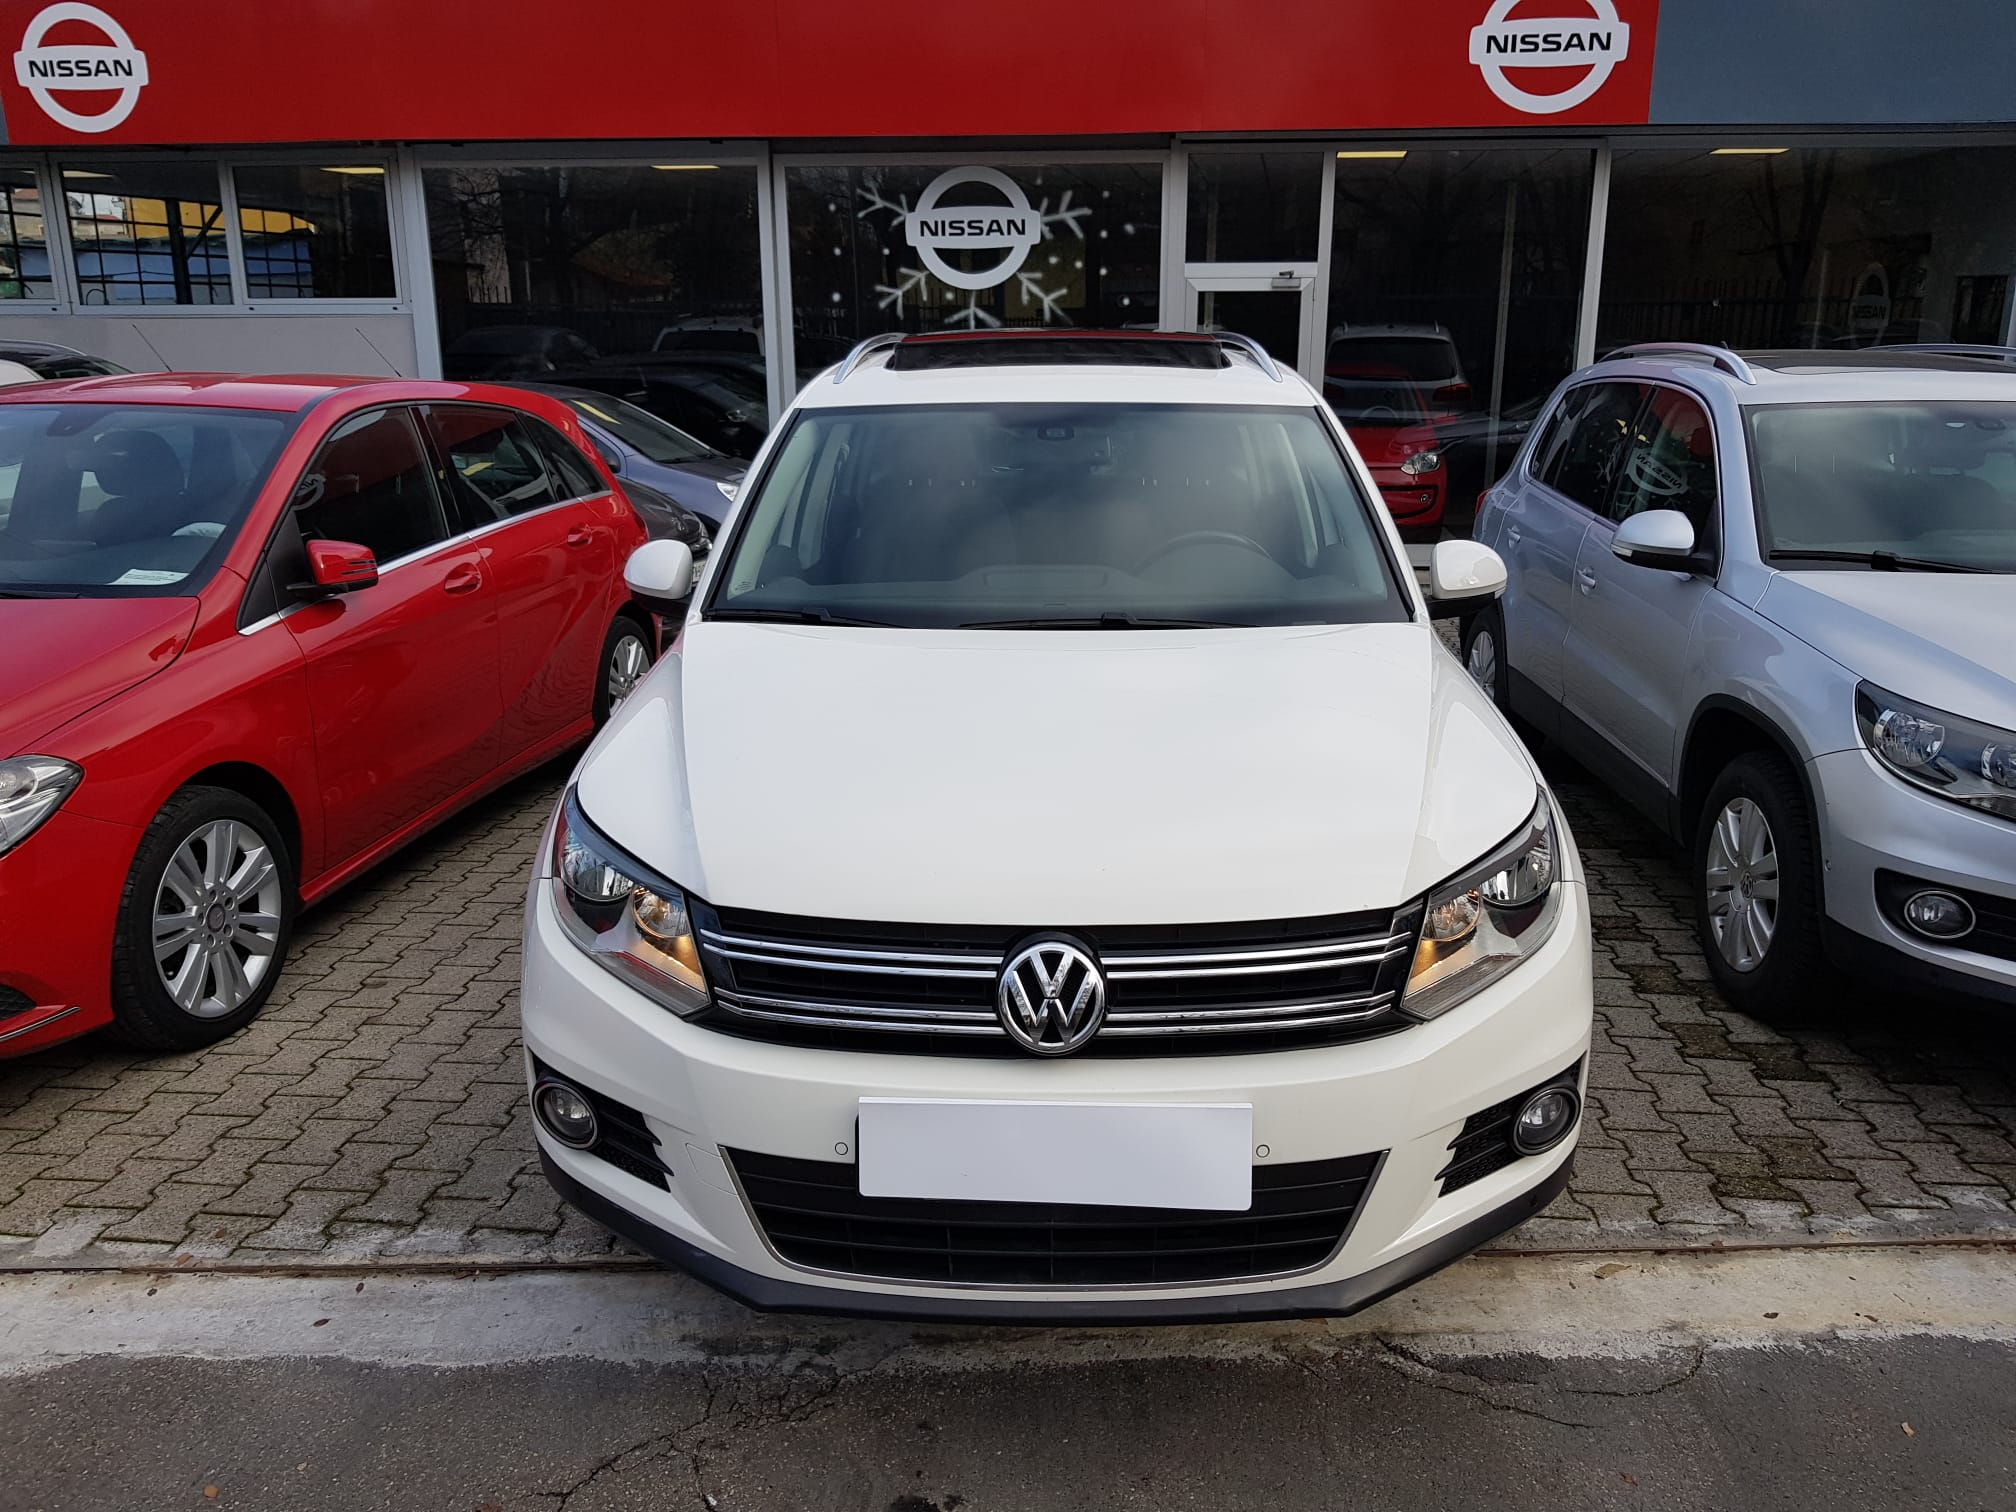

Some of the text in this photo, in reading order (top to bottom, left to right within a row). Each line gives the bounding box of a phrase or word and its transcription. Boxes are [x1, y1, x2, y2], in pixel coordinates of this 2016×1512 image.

[1486, 32, 1611, 53] NISSAN
[28, 59, 133, 77] NISSAN
[920, 219, 1026, 236] NISSAN
[1002, 945, 1100, 1049] VW
